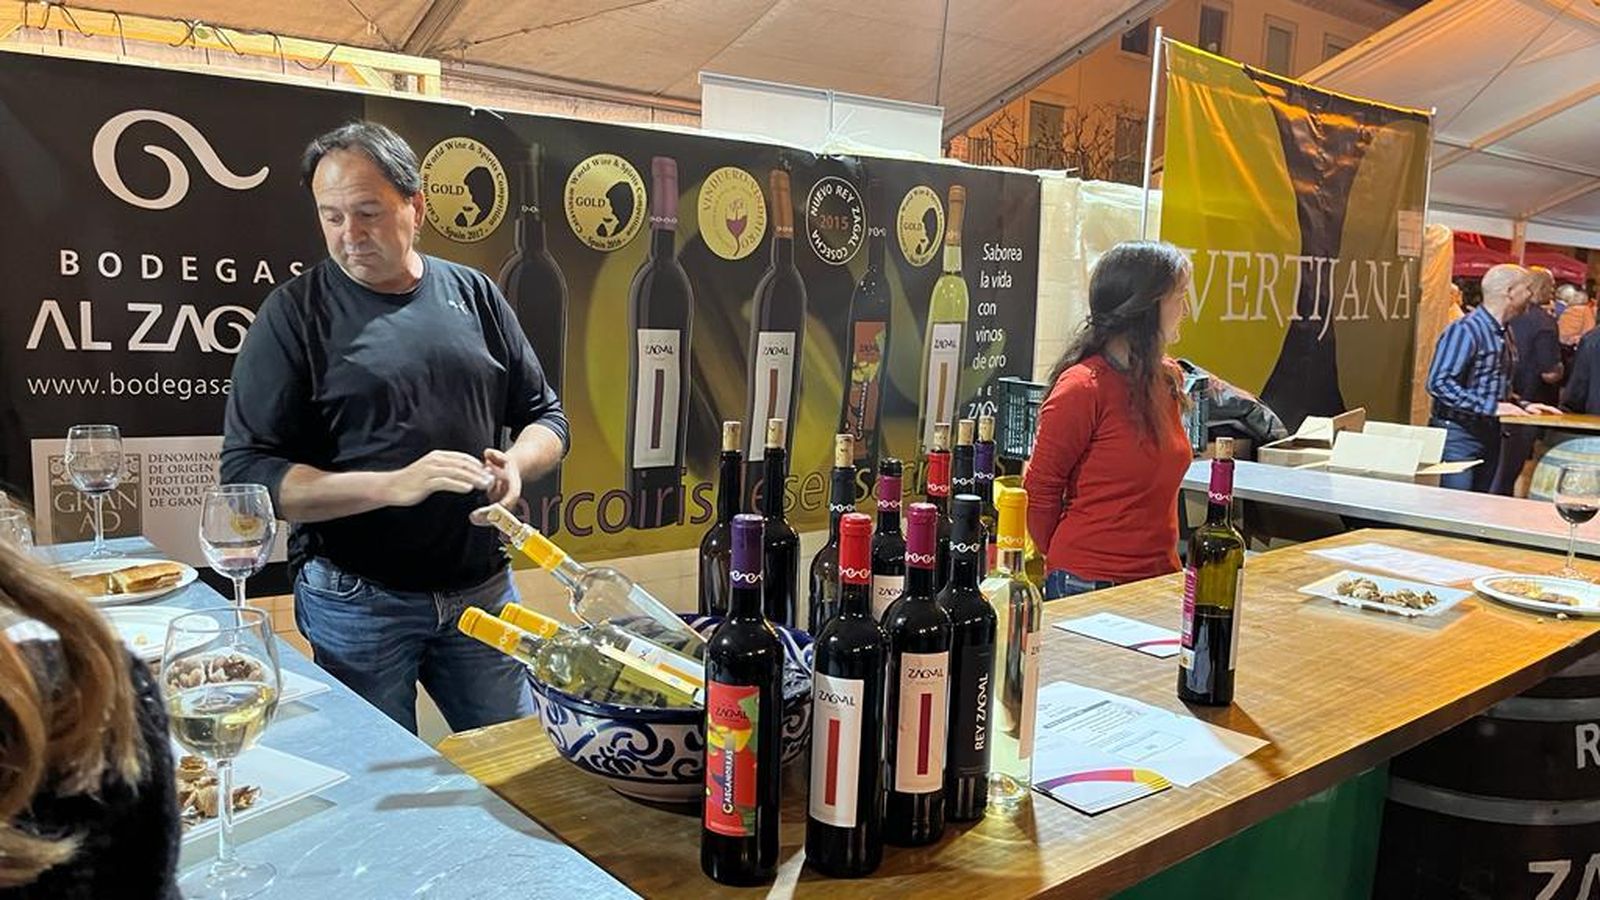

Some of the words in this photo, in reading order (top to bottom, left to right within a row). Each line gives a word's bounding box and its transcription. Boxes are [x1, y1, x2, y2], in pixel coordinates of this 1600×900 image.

[430, 183, 465, 196] GOLD
[575, 196, 606, 208] GOLD
[811, 183, 833, 217] NUEVO
[835, 185, 855, 203] REY
[848, 205, 861, 247] ZAGAL
[820, 214, 849, 231] 2015
[812, 229, 848, 260] COSECHA
[982, 243, 1023, 262] Saborea
[980, 270, 990, 289] la
[991, 269, 1012, 289] vida
[1177, 247, 1411, 341] VERTIJANA
[977, 301, 997, 316] con
[26, 299, 112, 351] AL
[975, 325, 1003, 343] vinos
[972, 352, 986, 371] de
[988, 354, 1007, 368] oro
[149, 464, 164, 474] DE
[168, 463, 213, 473] ORIGEN
[149, 474, 216, 486] PROTEGIDA
[148, 485, 180, 497] VINO
[184, 485, 199, 495] DE
[149, 497, 165, 507] DE
[975, 725, 985, 750] REY
